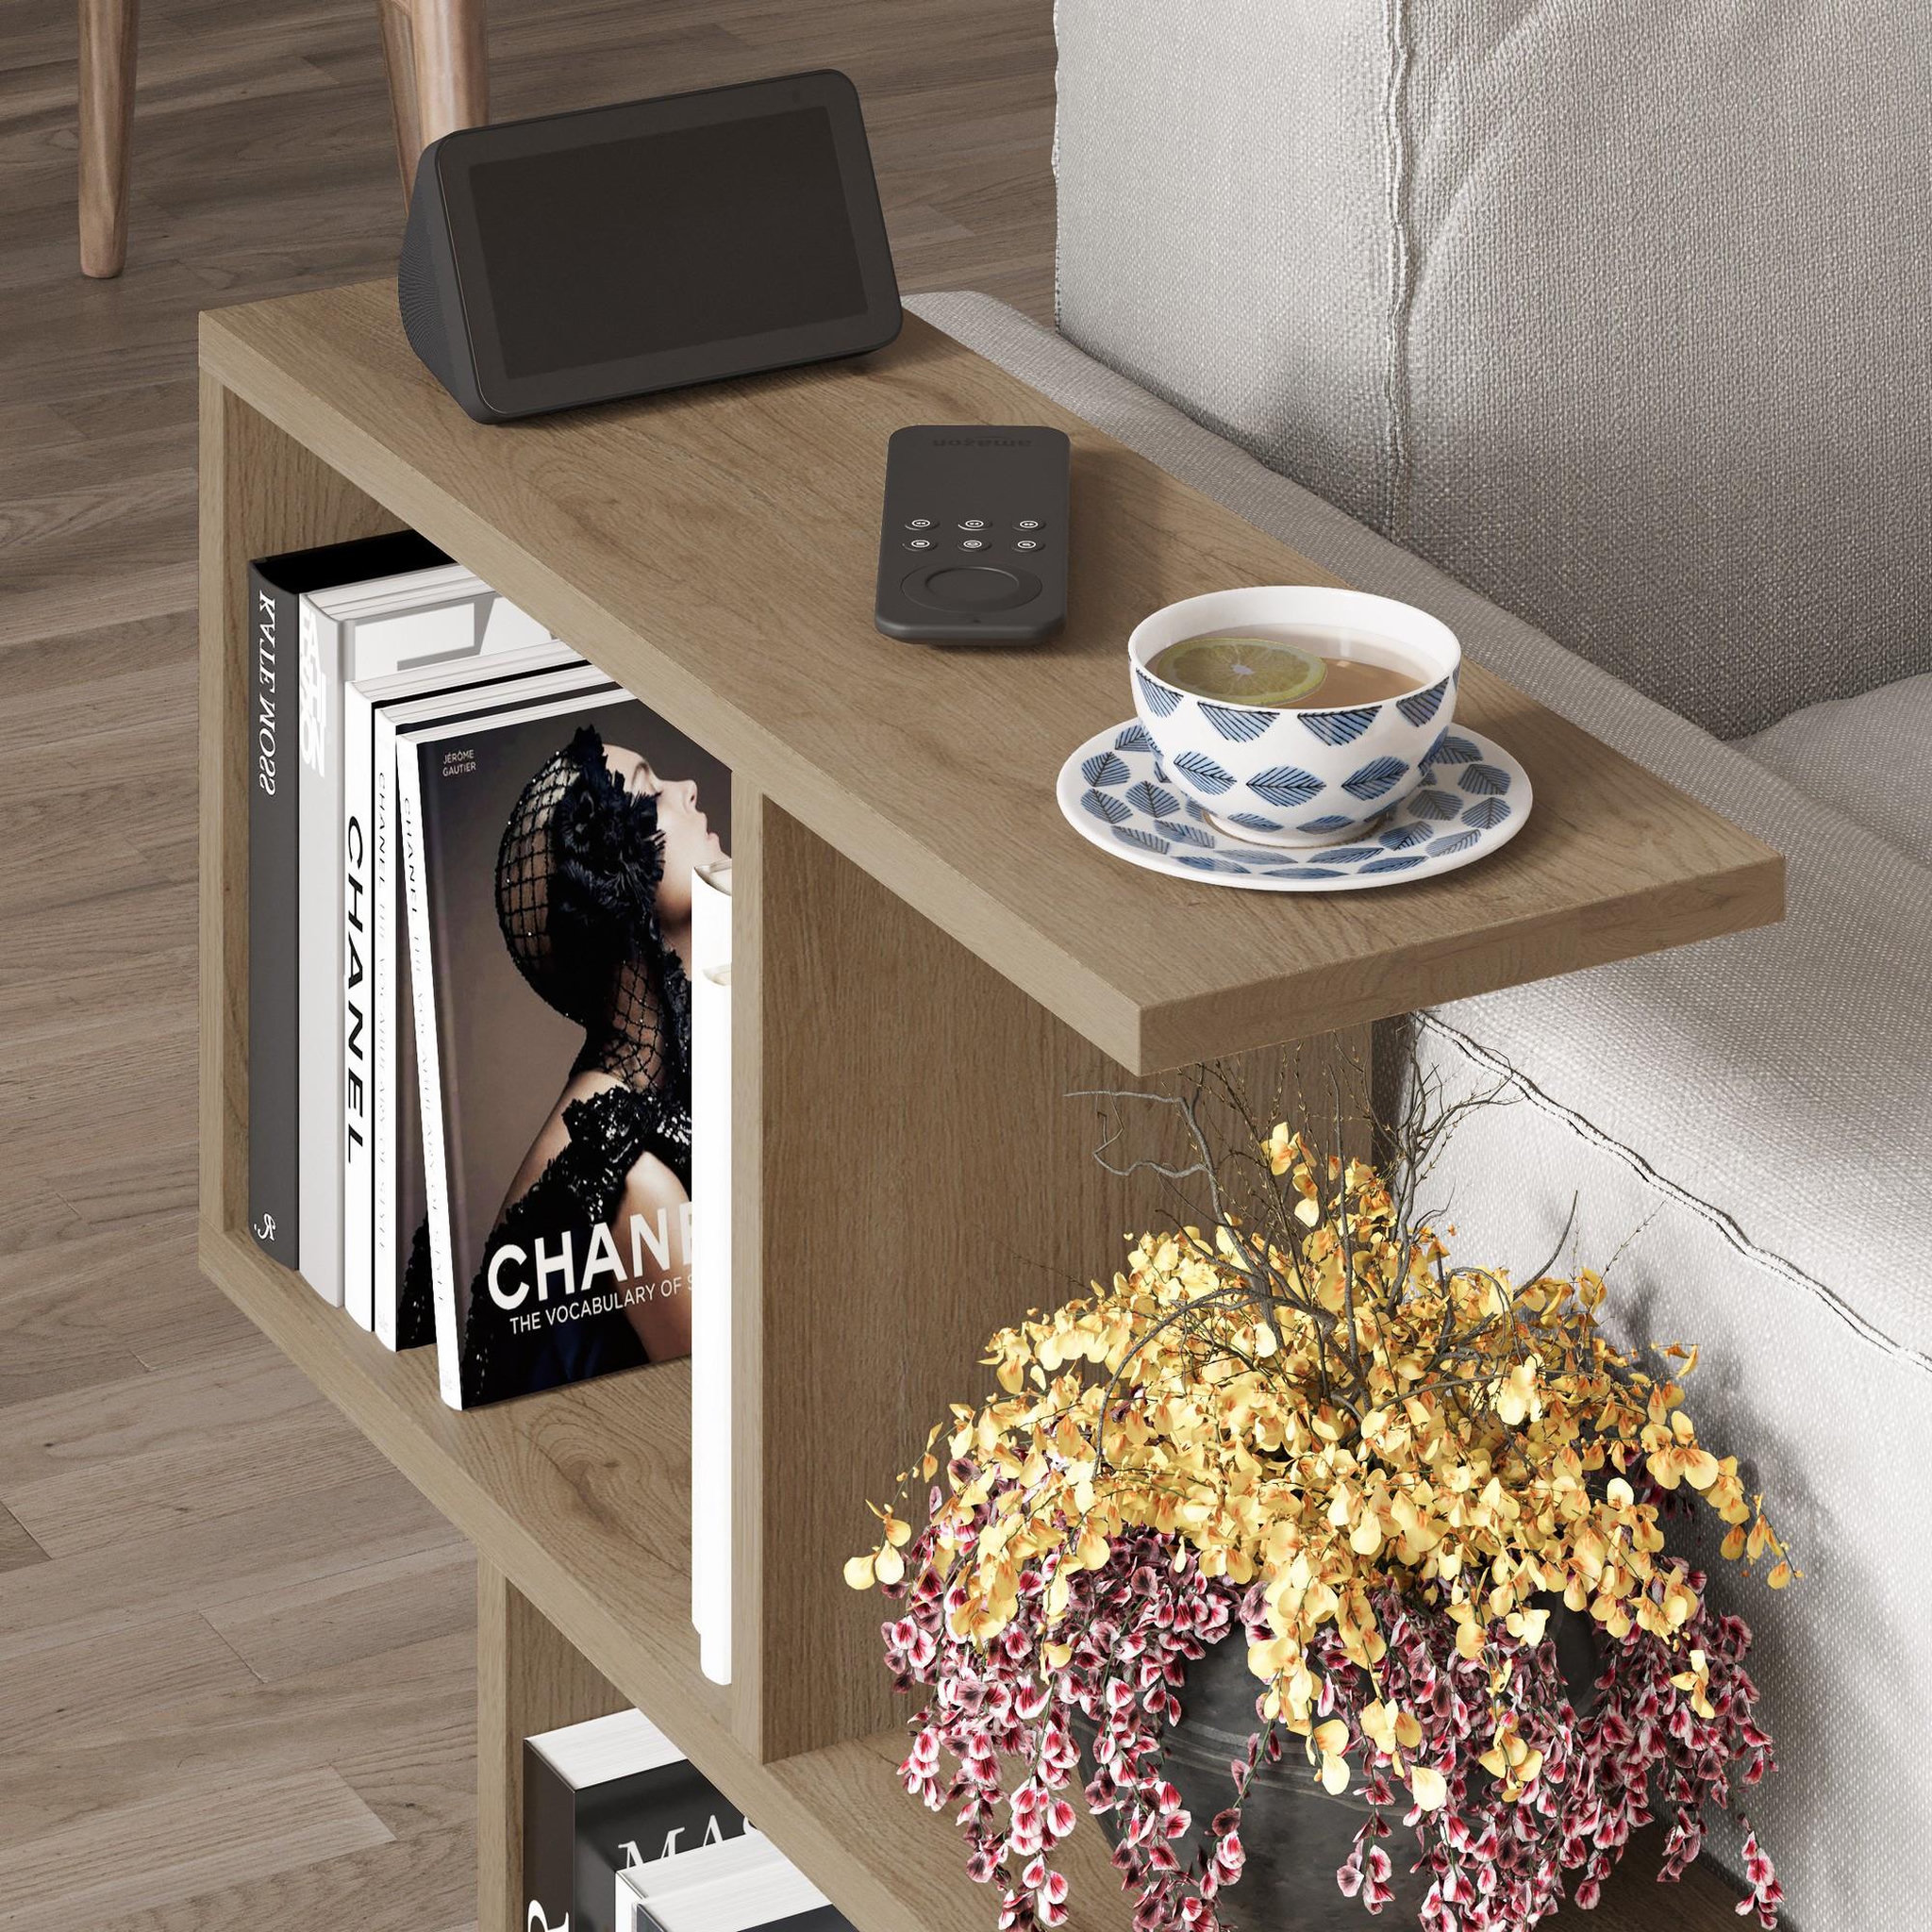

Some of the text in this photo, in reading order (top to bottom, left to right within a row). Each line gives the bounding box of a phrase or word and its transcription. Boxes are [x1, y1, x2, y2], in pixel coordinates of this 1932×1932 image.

[442, 761, 476, 777] GAUTIER
[347, 815, 364, 1164] CHANEL
[509, 1311, 541, 1335] THE
[545, 1283, 656, 1326] VOCABULARY
[660, 1277, 683, 1298] OF
